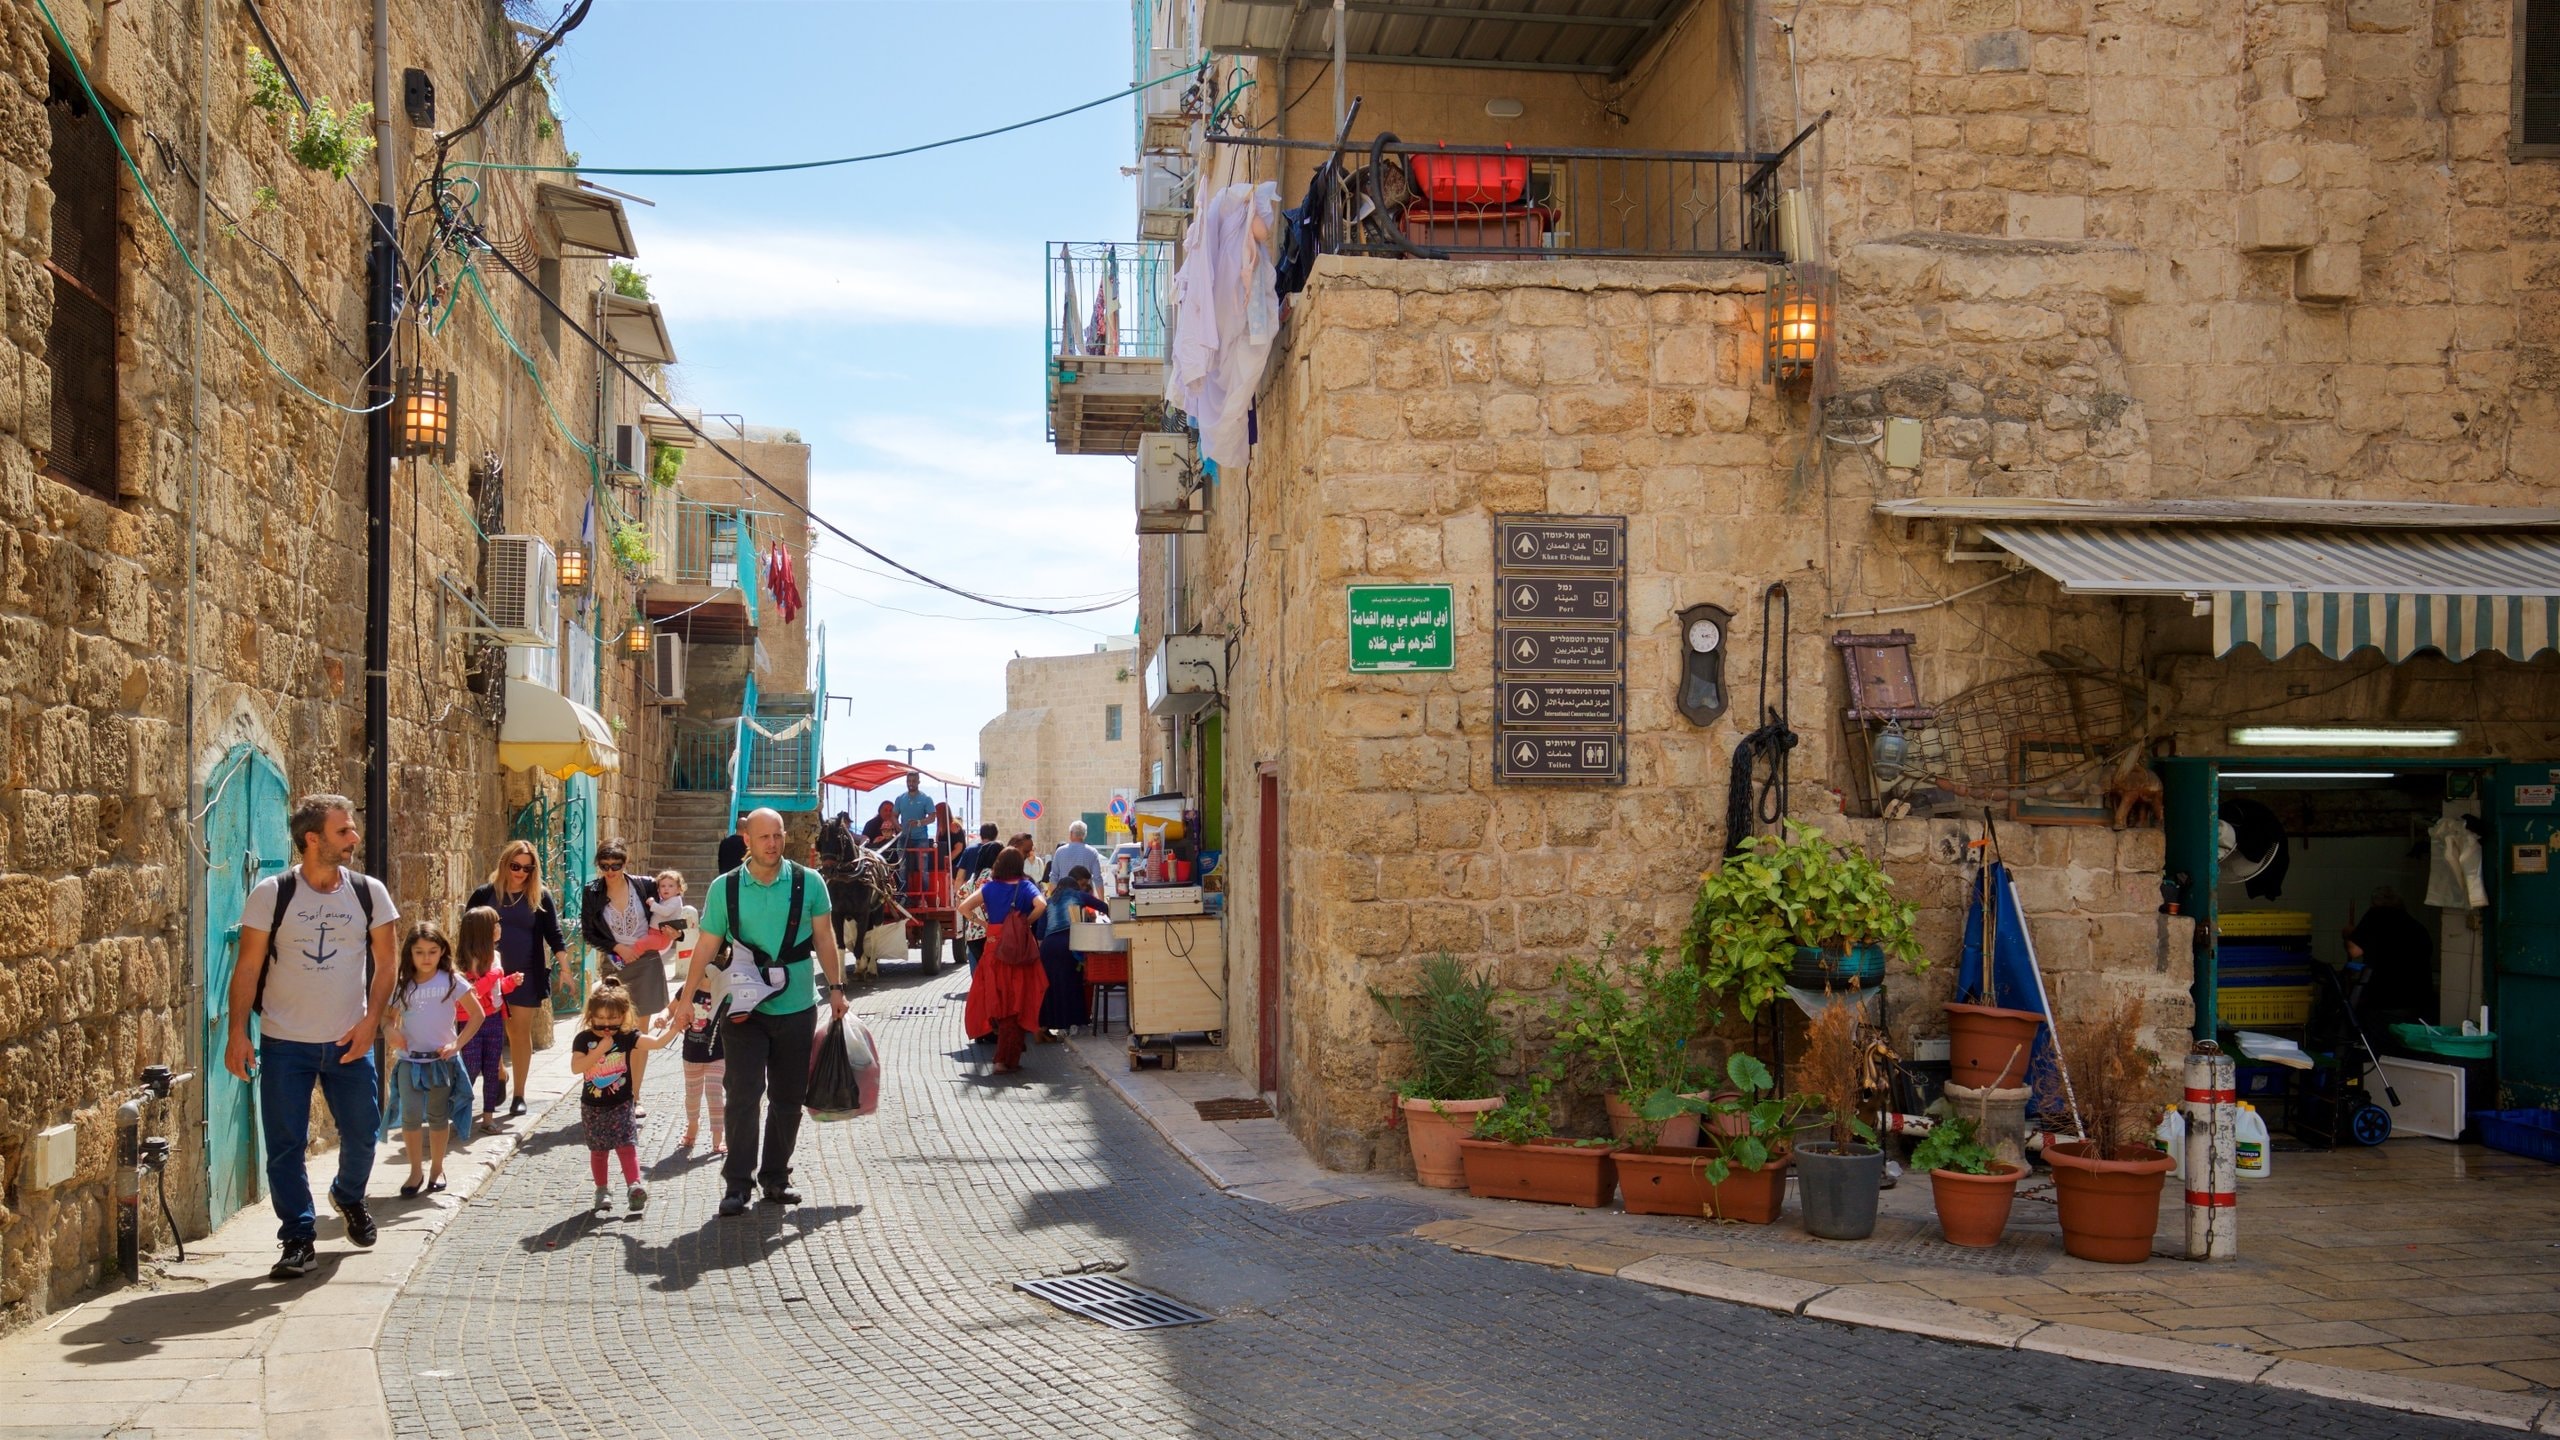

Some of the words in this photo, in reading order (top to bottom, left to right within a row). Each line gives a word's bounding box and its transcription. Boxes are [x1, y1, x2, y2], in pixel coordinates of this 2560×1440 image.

[1577, 531, 1591, 540] חאן
[1572, 542, 1587, 551] خان
[1560, 553, 1591, 561] El-Omdan
[1557, 583, 1573, 591] נמל
[1554, 593, 1579, 602] الميناء
[1351, 610, 1379, 629] القيامة
[1380, 614, 1395, 629] يوم
[1410, 610, 1432, 627] الناس
[1587, 636, 1610, 644] מנהרת
[1590, 646, 1605, 656] نفق
[1876, 650, 1884, 658] 12
[1552, 657, 1580, 665] Templar
[1583, 657, 1607, 665] Tunnel
[1571, 710, 1596, 718] Conservation
[1545, 740, 1577, 748] שירותים
[297, 904, 324, 922] Sail
[325, 913, 353, 926] away
